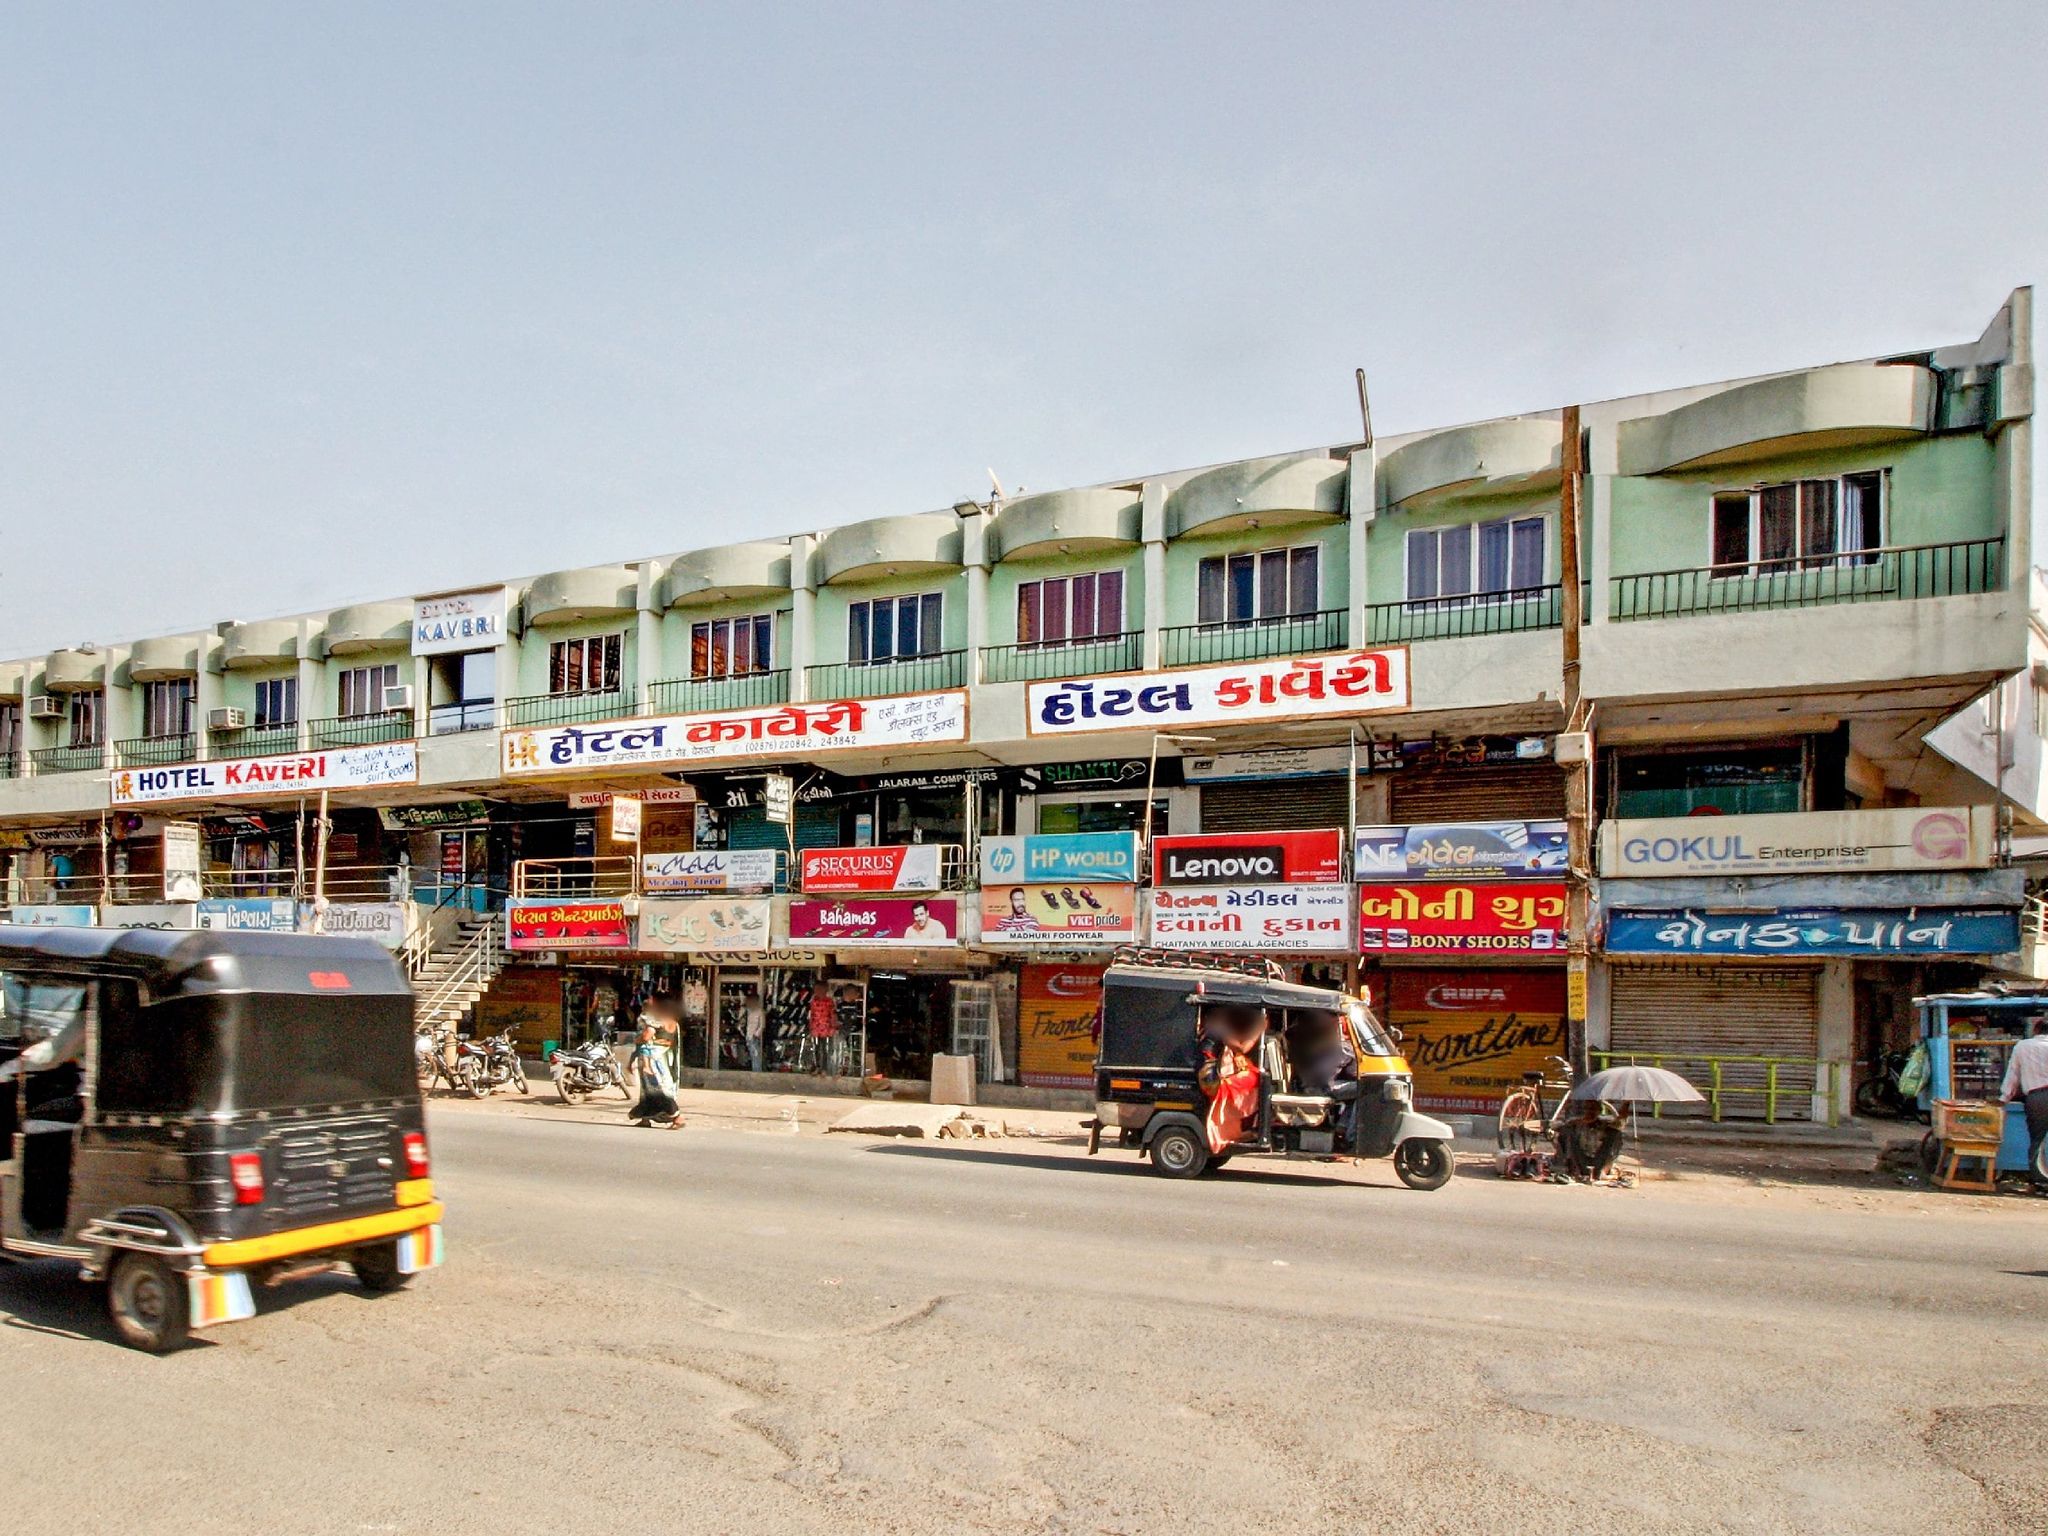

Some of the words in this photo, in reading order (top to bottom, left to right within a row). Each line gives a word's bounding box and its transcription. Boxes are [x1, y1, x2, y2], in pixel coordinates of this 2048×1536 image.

[418, 615, 498, 642] KAVERI
[821, 735, 857, 747] 243842
[139, 767, 215, 791] HOTEL
[225, 756, 326, 785] KAVERI
[388, 761, 415, 779] ROOMS
[1044, 760, 1119, 782] SHAKTI
[879, 776, 928, 788] JALARAM
[1031, 848, 1061, 869] HP
[1064, 851, 1128, 867] WORLD
[1624, 836, 1754, 863] GOKUL
[1759, 846, 1866, 860] Enterprise
[661, 854, 727, 876] MAA
[820, 855, 894, 871] SECURUS
[992, 848, 1014, 873] hp
[1169, 855, 1275, 878] Lenovo
[821, 868, 843, 877] CCTV
[852, 867, 894, 876] Surveillance
[1227, 889, 1298, 906] મેડીકલ
[1362, 887, 1475, 920] બોની
[820, 908, 877, 926] Bahamas
[1069, 915, 1094, 927] VKC
[1095, 912, 1121, 927] pride
[1156, 913, 1243, 933] દવાની
[1263, 917, 1342, 937] દુકાન
[1009, 932, 1051, 940] MADHURI
[1053, 932, 1104, 940] FOOTWEAR
[1656, 910, 1800, 949] રોનક
[1841, 920, 1953, 950] પાન
[713, 934, 758, 948] SHOES
[1155, 940, 1208, 948] CHAITANYA
[1210, 940, 1254, 948] MEDICAL
[1256, 939, 1309, 948] AGENCIES
[1410, 935, 1462, 949] BONY
[1466, 935, 1530, 949] SHOES
[1441, 987, 1507, 1001] RUPA
[1391, 1012, 1567, 1066] Frontline
